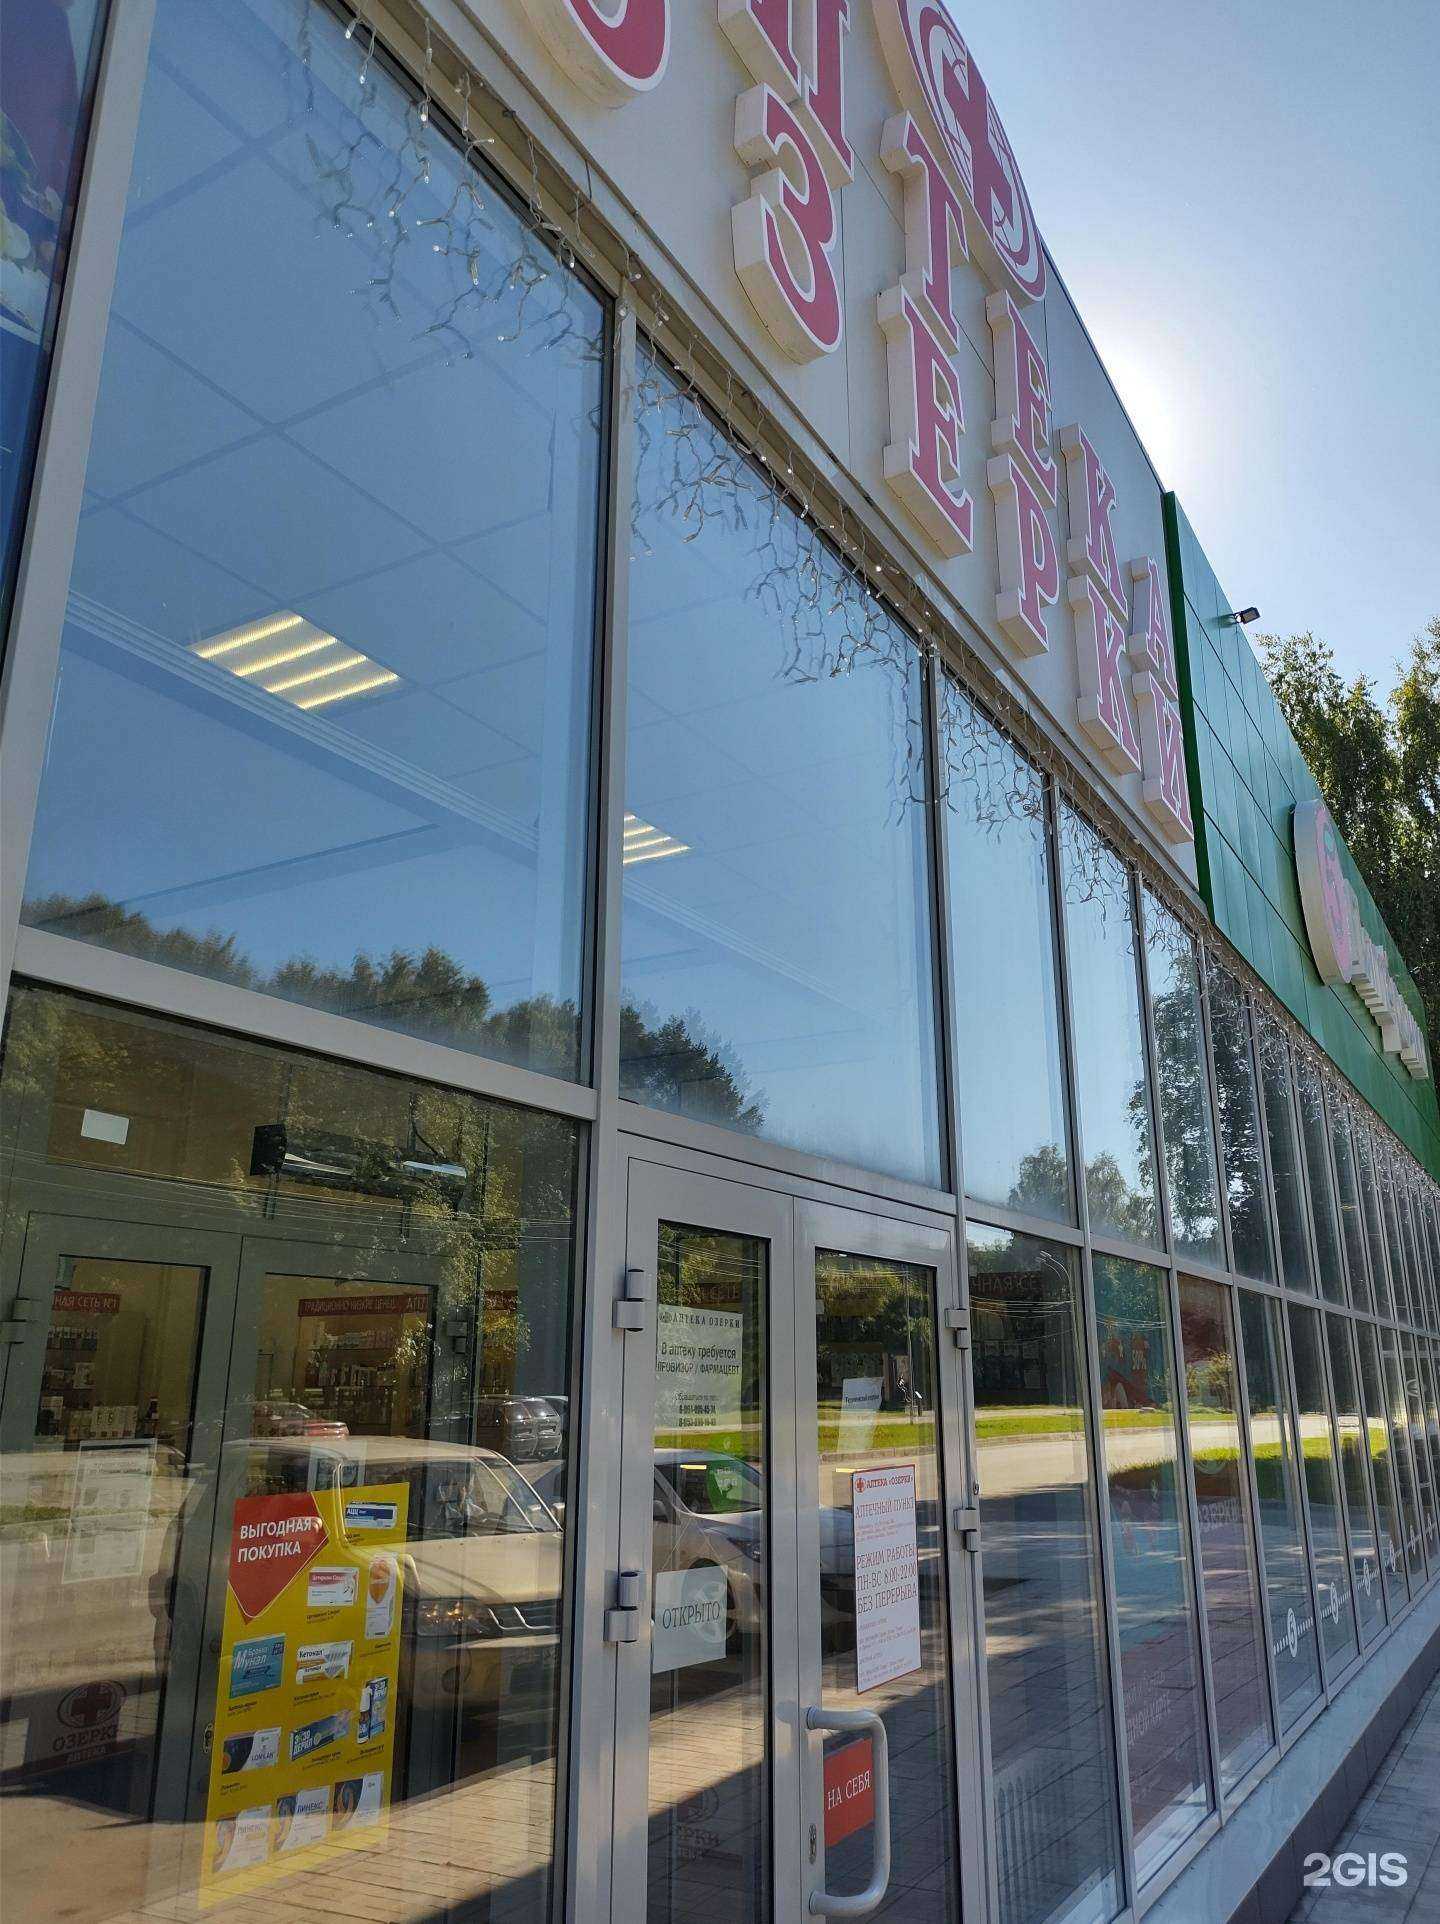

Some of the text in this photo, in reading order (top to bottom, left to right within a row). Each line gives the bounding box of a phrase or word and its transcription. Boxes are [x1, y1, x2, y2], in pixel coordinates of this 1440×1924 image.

[672, 1311, 740, 1329] АПТЕКА ОЗЕРКИ
[661, 1341, 737, 1361] В аптеку требуется
[657, 1361, 693, 1374] ПРОВИЗОР
[699, 1364, 740, 1377] ФАРМАЦЕВТ
[894, 1496, 914, 1513] ПУНКТ
[240, 1517, 312, 1540] ВЫГОДНАЯ
[237, 1541, 302, 1563] ПОКУПКА
[856, 1543, 916, 1570] РЕЖИМ РАБОТЫ
[856, 1570, 882, 1592] ПН-ВС
[857, 1582, 918, 1615] БЕЗ ПЕРЕРЫВА
[662, 1600, 721, 1630] ОТКРЫТО
[828, 1770, 871, 1810] НА СЕБЯ
